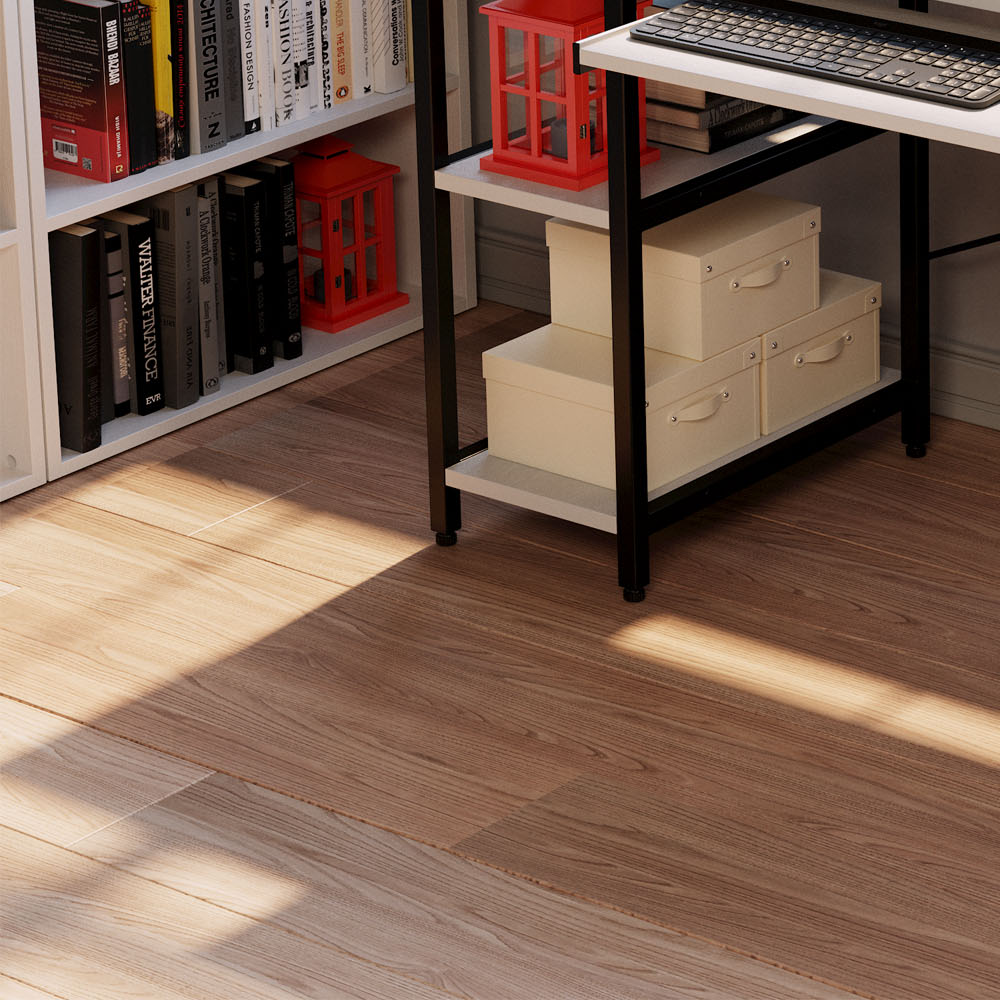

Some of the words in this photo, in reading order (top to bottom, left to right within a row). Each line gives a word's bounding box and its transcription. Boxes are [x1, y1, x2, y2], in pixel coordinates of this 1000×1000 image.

[176, 4, 185, 25] 2014
[243, 3, 252, 49] FASHION
[105, 19, 118, 53] BHENDI
[305, 11, 315, 67] architecture
[336, 31, 345, 47] THE
[336, 47, 346, 58] BIG
[391, 7, 400, 67] Conversations
[107, 52, 121, 86] BAZAAR
[245, 51, 255, 92] DESIGN
[336, 58, 346, 76] SLEEP
[281, 68, 295, 121] BOOK
[200, 217, 211, 258] Clockwork
[137, 236, 155, 309] WALTER
[200, 258, 213, 286] Orange
[142, 308, 158, 383] FINANCE
[145, 392, 162, 406] EVR
